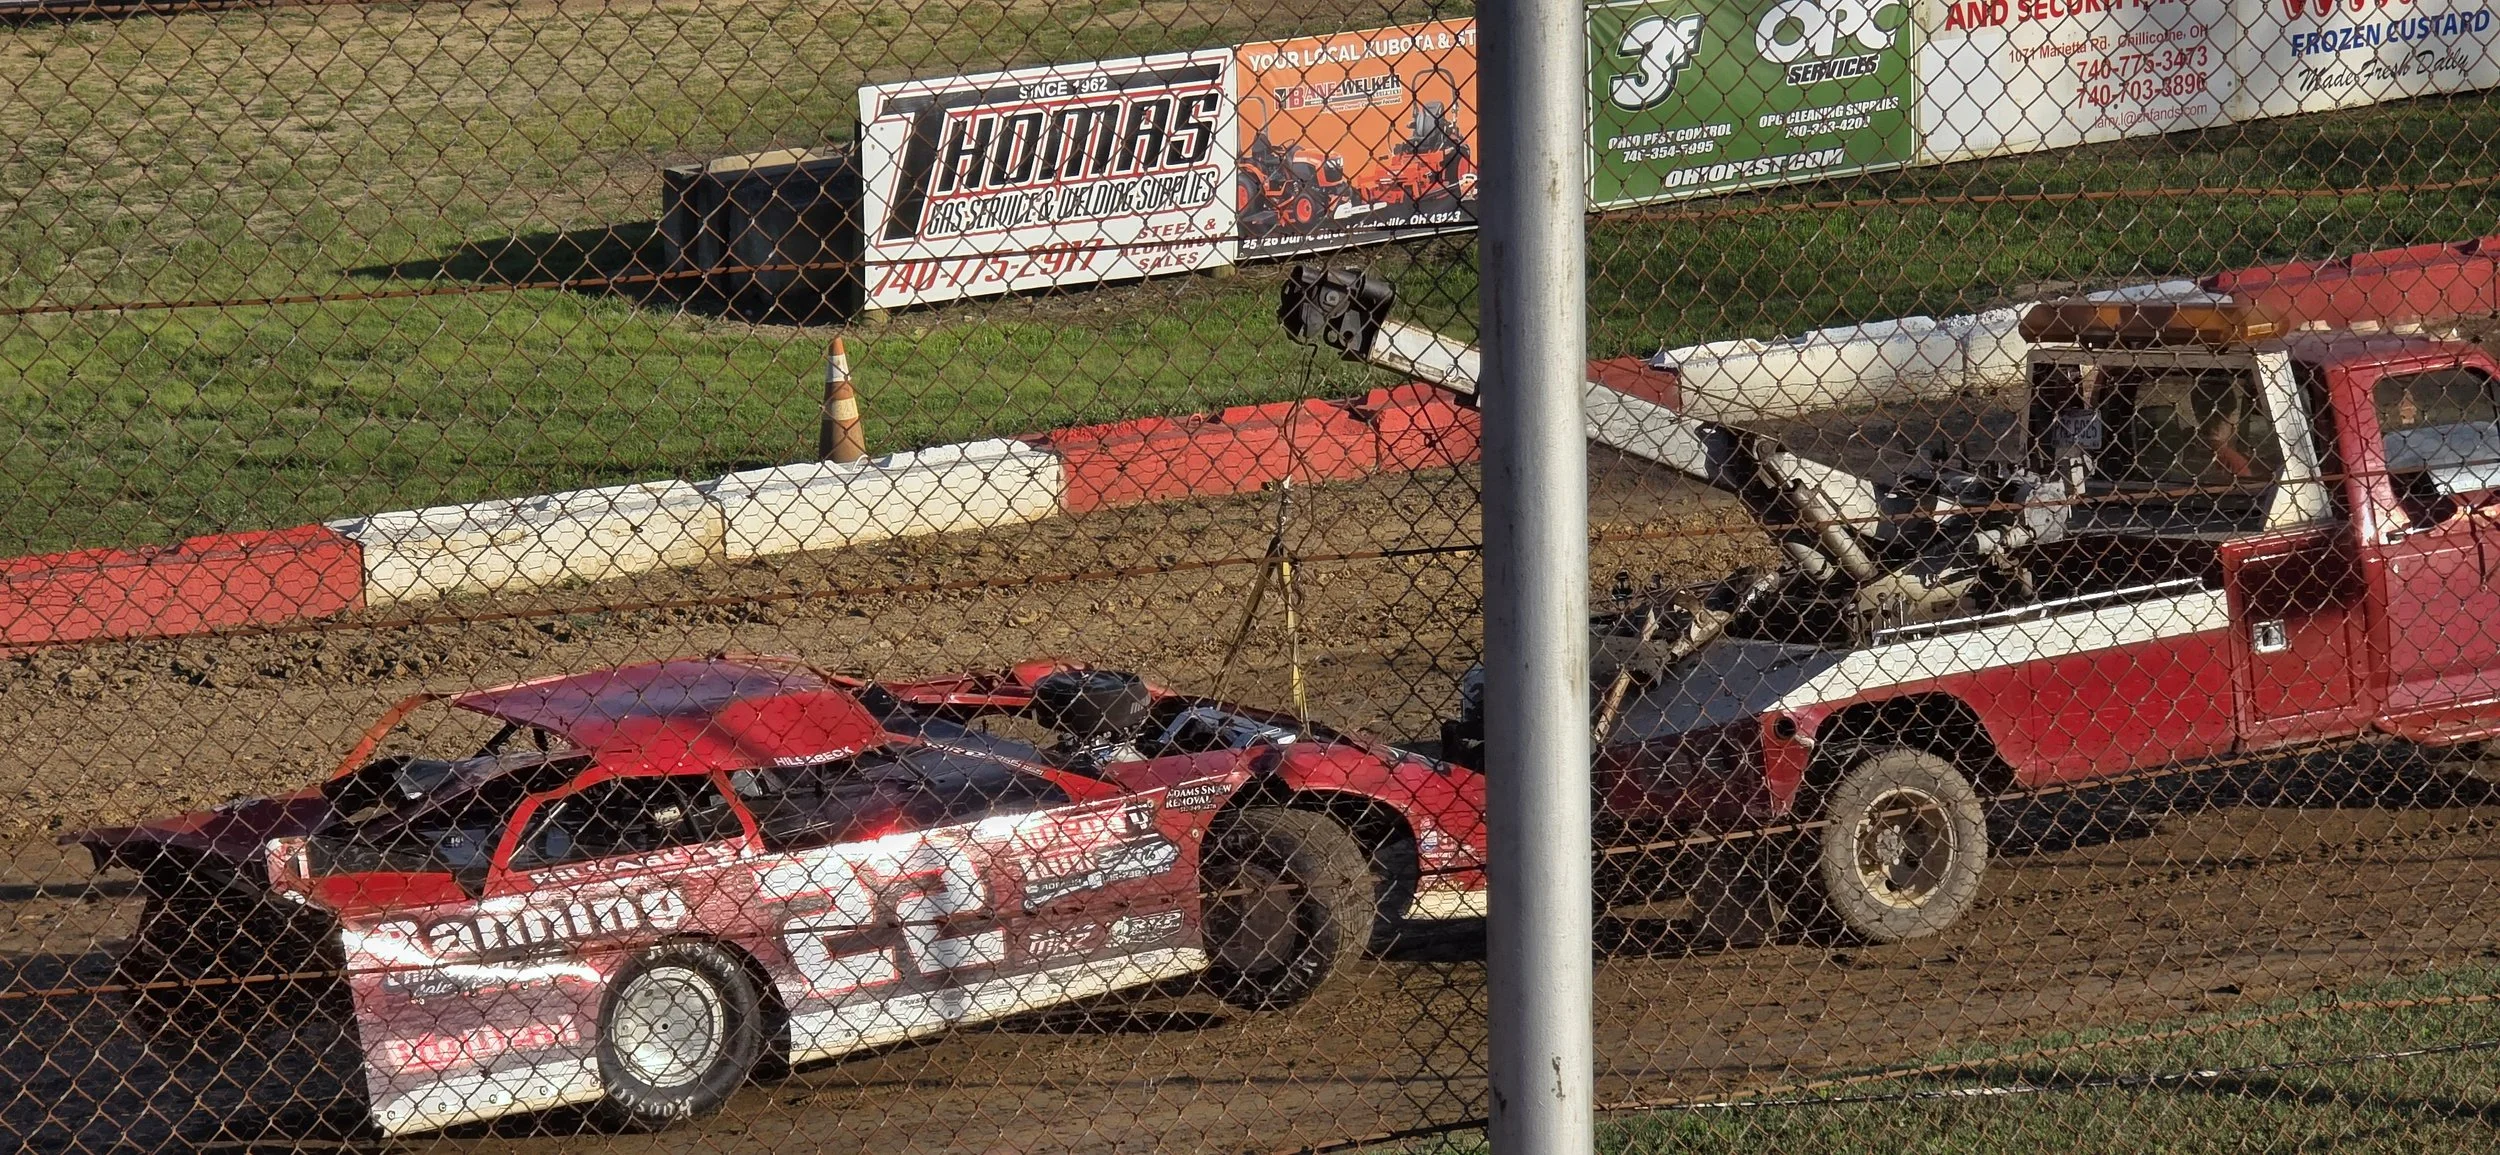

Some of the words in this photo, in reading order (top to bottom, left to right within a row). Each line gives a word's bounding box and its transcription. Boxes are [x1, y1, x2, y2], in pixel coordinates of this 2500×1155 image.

[1755, 0, 1900, 64] OPC
[1945, 0, 2008, 31] AND
[2291, 22, 2381, 57] FROZEN
[2386, 9, 2490, 44] CUSTARD
[1249, 50, 1300, 72] YOUR
[1304, 45, 1361, 66] LOCAL
[1364, 32, 1437, 59] KUBOTA
[1437, 32, 1451, 48] &
[2009, 48, 2036, 63] 1071
[2040, 40, 2086, 58] Marietta
[2190, 24, 2208, 38] OH
[1787, 55, 1880, 84] SERVICES
[2077, 46, 2208, 82] 740-775-3473
[2298, 66, 2353, 92] Made
[2357, 52, 2410, 87] Fresh
[2415, 47, 2469, 75] Daily
[1018, 81, 1068, 100] SINCE
[1072, 77, 1108, 96] 1962
[2077, 72, 2208, 109] 740-703-3896
[1759, 113, 1783, 128] OPC
[1786, 105, 1845, 124] CLEANING
[1845, 96, 1899, 116] SUPPLIES
[880, 63, 1222, 240] THOMAS
[1608, 134, 1641, 150] OHIO
[1643, 130, 1675, 146] PEST
[1676, 123, 1732, 141] CONTROL
[1623, 140, 1714, 163] 740-354-5995
[1665, 148, 1845, 188] OHIOPESTCOM
[927, 199, 967, 236] GAS
[967, 190, 1040, 232] SERVICE
[1040, 189, 1054, 220] &
[1057, 178, 1138, 220] WELDING
[1138, 170, 1217, 211] SUPPLIES
[1137, 221, 1196, 240] STEEL
[1204, 218, 1217, 231] &
[873, 238, 1105, 297] 740-775-2917
[1137, 251, 1199, 270] SALES
[773, 746, 854, 766] HILSABECK
[1166, 787, 1200, 799] ADAMS
[1166, 796, 1212, 808] REMOVAL
[748, 845, 1006, 999] 22
